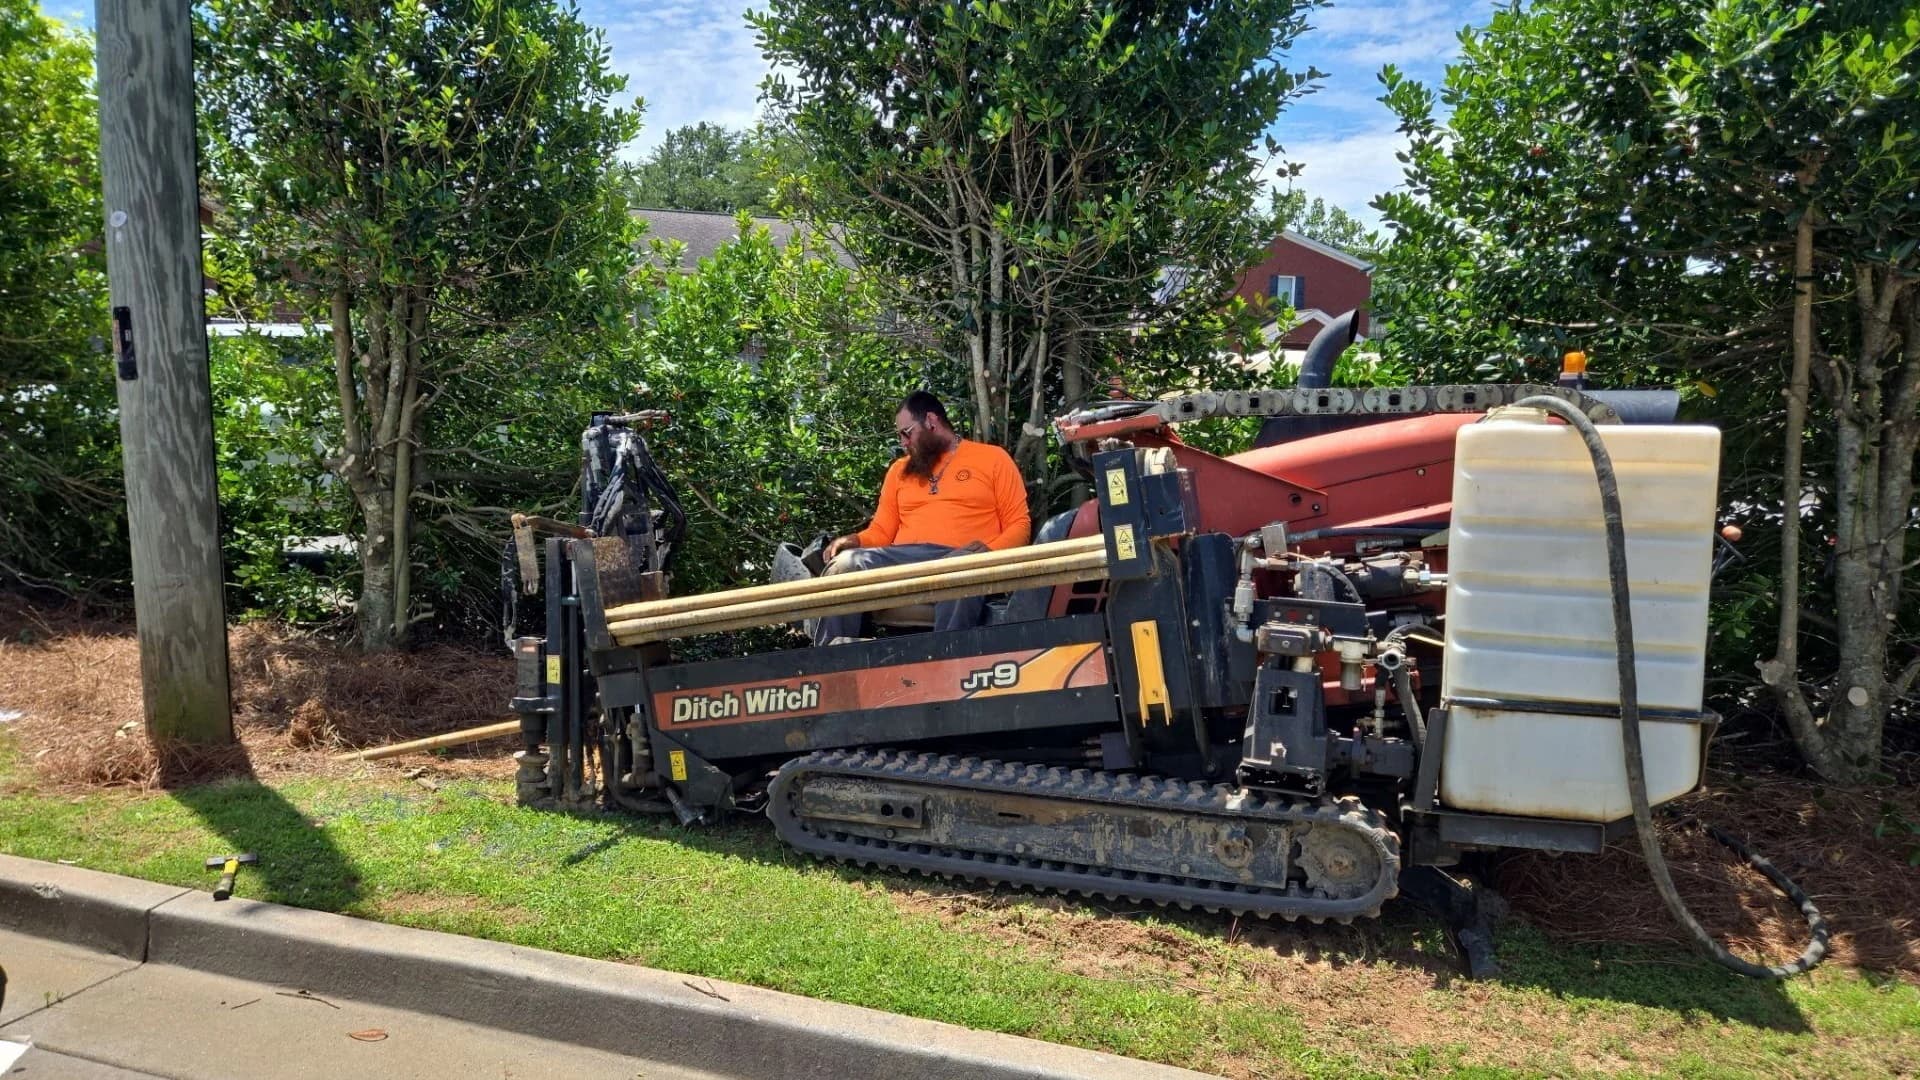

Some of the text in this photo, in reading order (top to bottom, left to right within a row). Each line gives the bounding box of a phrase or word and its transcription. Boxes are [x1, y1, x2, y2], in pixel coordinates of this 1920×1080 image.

[963, 663, 1018, 689] JT9
[673, 684, 818, 722] Ditch Witch
